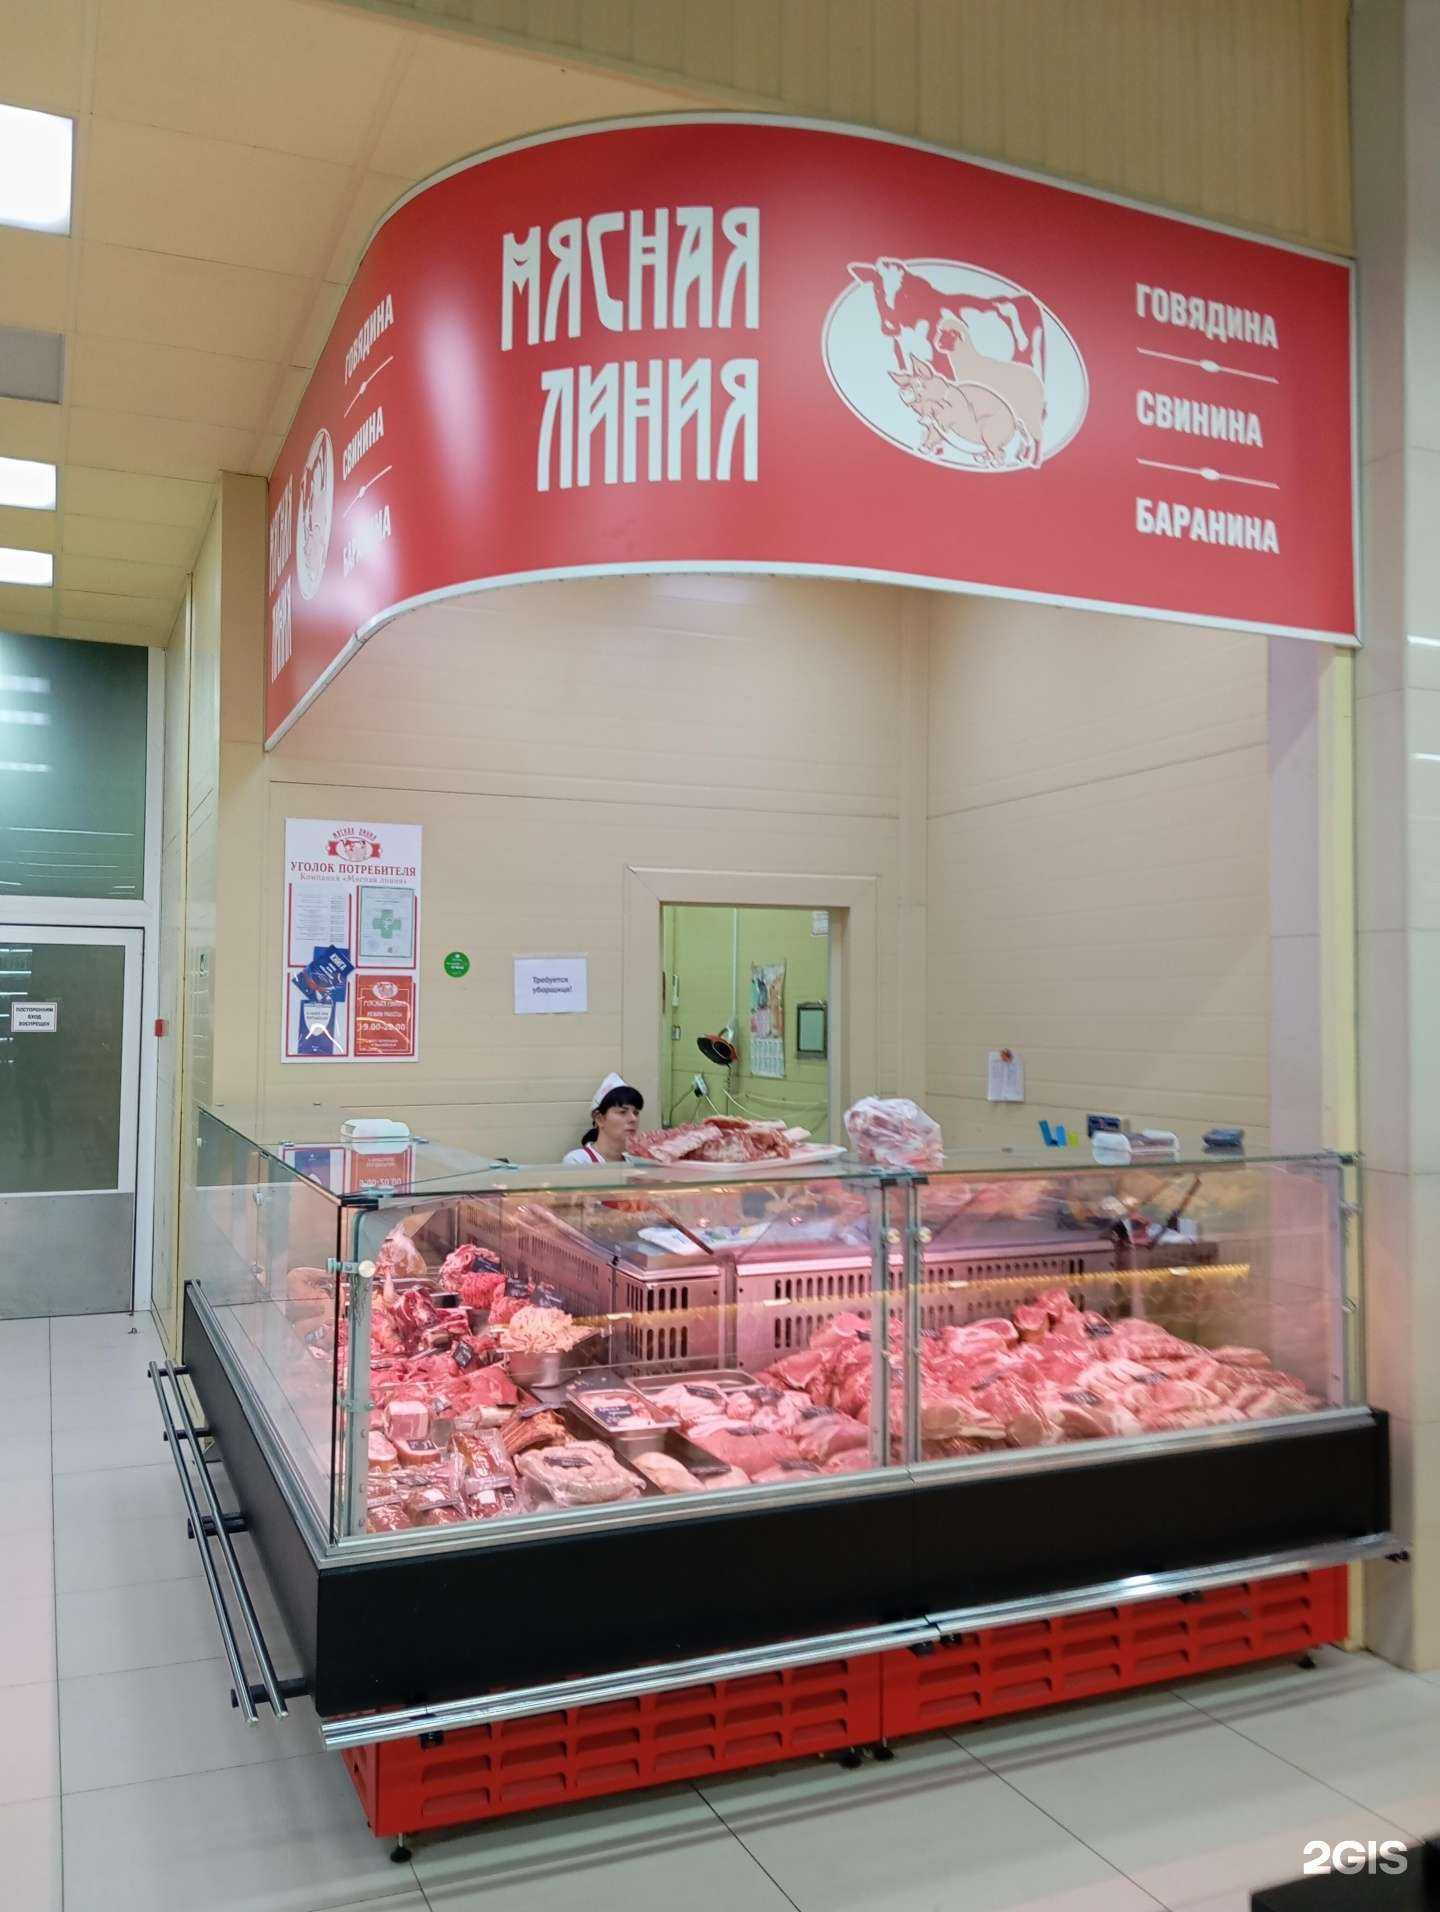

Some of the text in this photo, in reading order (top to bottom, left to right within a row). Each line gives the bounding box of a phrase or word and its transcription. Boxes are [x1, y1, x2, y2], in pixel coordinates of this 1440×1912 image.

[501, 205, 761, 351] МЯСНАЯ
[343, 293, 395, 385] ГОВЯДИНА
[1135, 281, 1280, 350] ГОВЯДИНА
[342, 405, 386, 481] СВИНИНА
[537, 357, 760, 492] ЛИНИЯ
[1135, 388, 1265, 450] СВИНИНА
[1135, 496, 1281, 556] БАРАНИНА
[290, 861, 416, 876] УГОЛОК ПОТРЕБИТЕЛЯ
[532, 976, 568, 984] Требуется
